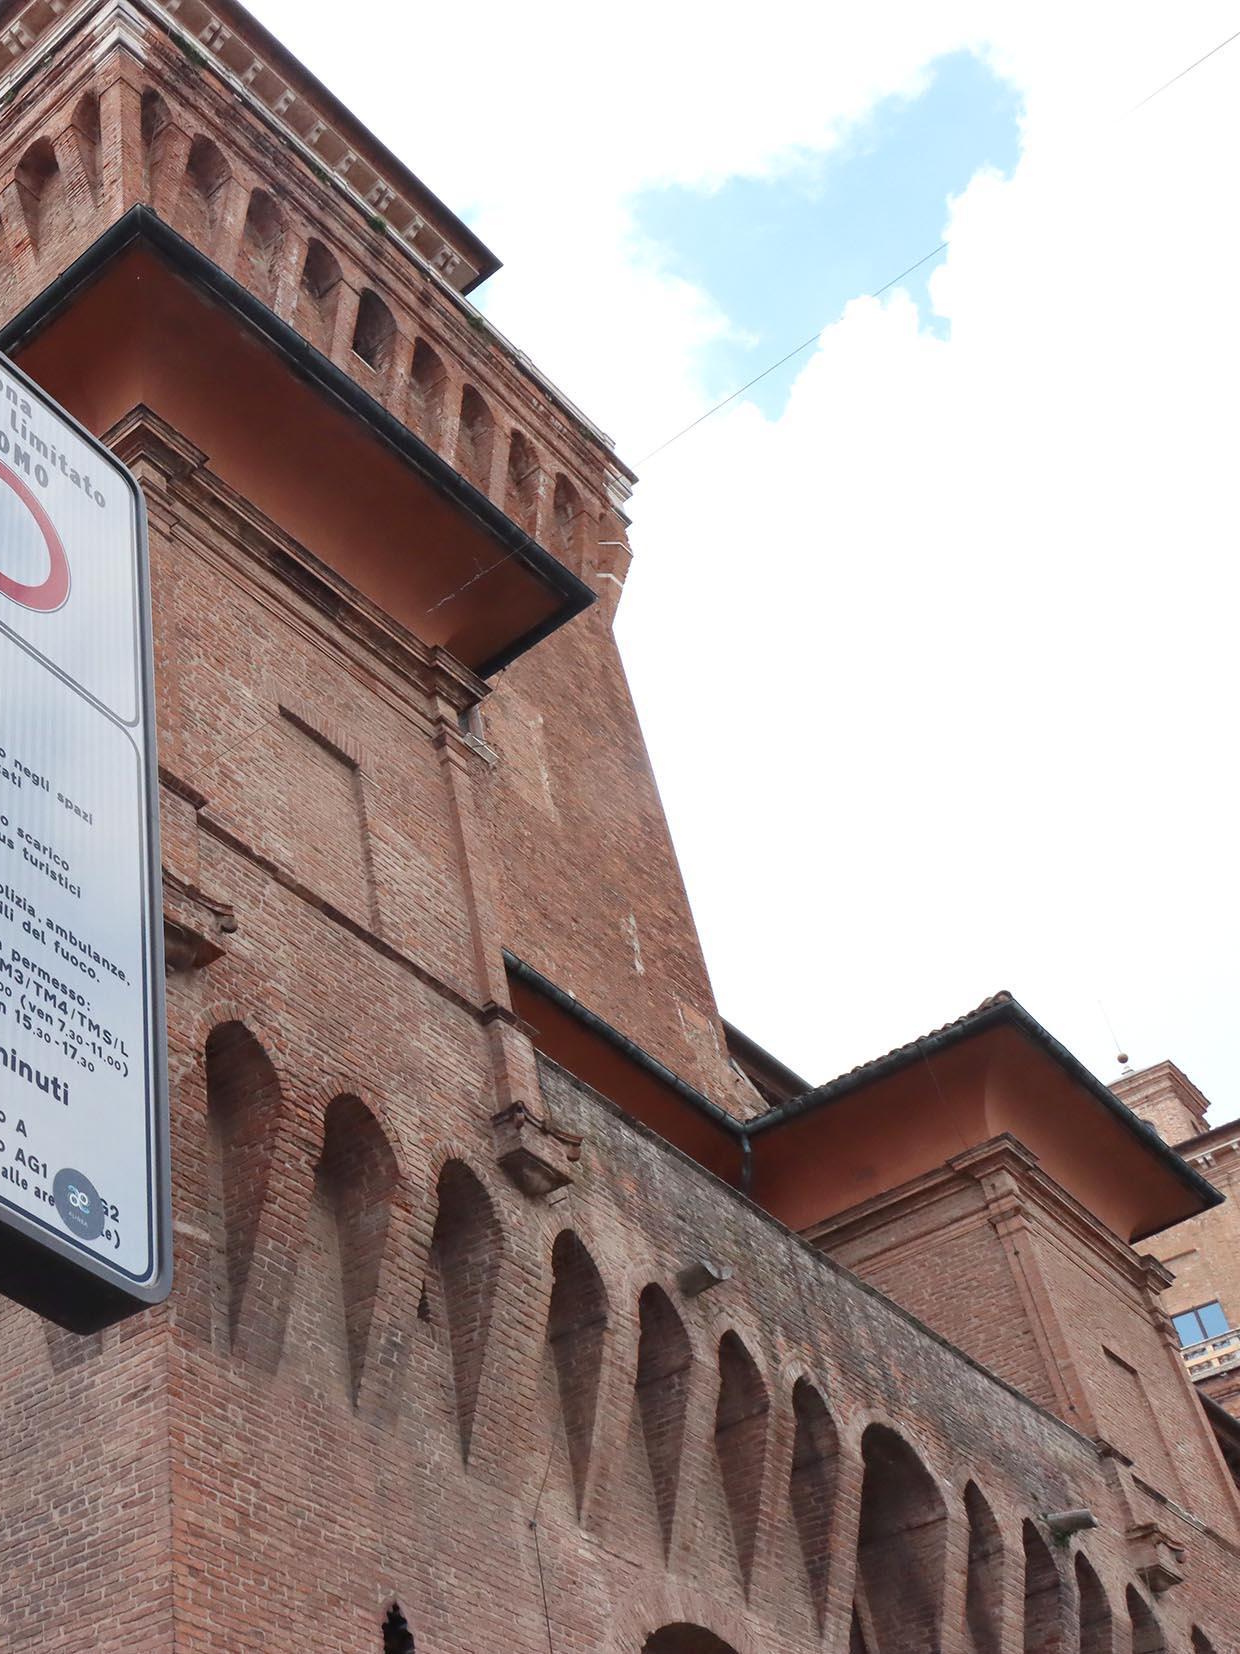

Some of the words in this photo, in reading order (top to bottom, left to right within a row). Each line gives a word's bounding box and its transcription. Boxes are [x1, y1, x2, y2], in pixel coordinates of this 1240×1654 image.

[10, 408, 106, 509] limitato
[13, 758, 50, 793] negli
[56, 792, 93, 826] spazi
[16, 826, 70, 872] scarico
[22, 846, 81, 900] turistici
[10, 947, 91, 1012] permesso:
[21, 919, 47, 946] del
[53, 939, 101, 984] fuoco.
[45, 917, 131, 987] ambulanze,
[15, 1118, 28, 1139] A
[0, 1165, 29, 1191] alle
[14, 1147, 48, 1180] AG1
